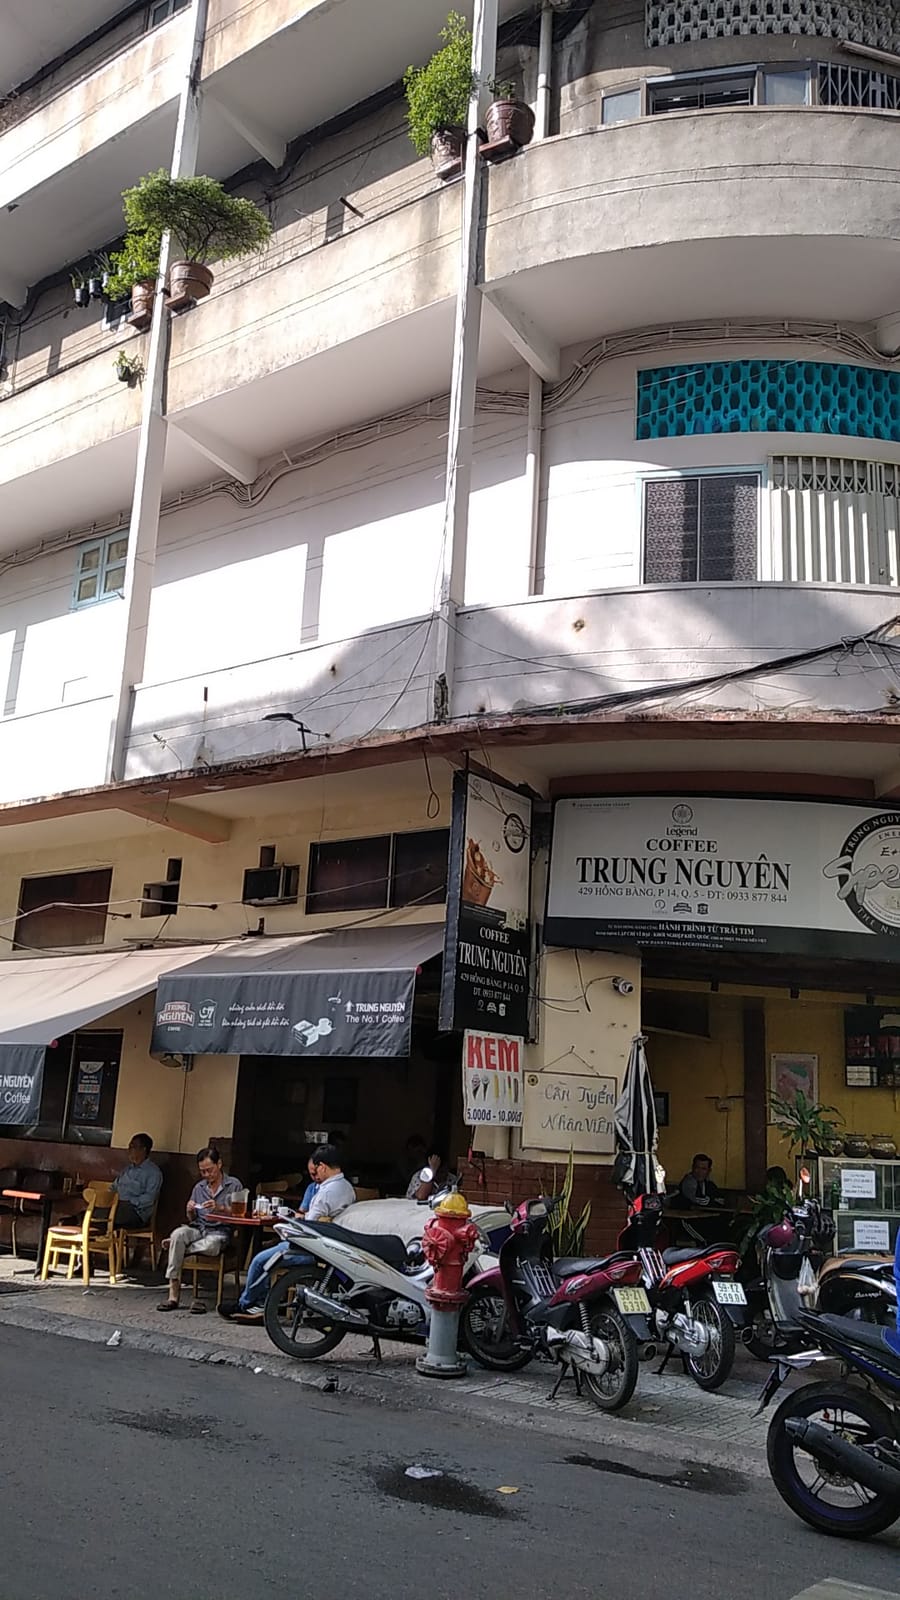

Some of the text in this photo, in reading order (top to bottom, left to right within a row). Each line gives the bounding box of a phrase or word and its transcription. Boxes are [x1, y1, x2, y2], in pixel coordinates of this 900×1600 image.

[666, 827, 698, 837] Legend
[646, 839, 718, 853] COFFEE
[576, 853, 791, 891] TRUNG NGUYÊN
[577, 887, 593, 895] 429
[595, 884, 623, 896] HỒNG
[658, 888, 664, 897] P
[693, 890, 699, 898] 5
[707, 891, 725, 900] ĐT:
[727, 892, 750, 901] 0933
[752, 893, 769, 902] 877
[771, 894, 788, 903] 844
[479, 926, 510, 944] COFFEE
[739, 927, 755, 935] TIM
[459, 941, 528, 977] TRUNG NGUYÊN
[356, 1001, 405, 1012] TRUNG NGUYÊN
[345, 1014, 405, 1023] The No.1 Coffee
[467, 1035, 519, 1072] KEM
[3, 1073, 35, 1088] NGUYÊN
[4, 1091, 31, 1104] Coffee
[467, 1108, 491, 1121] 5.000đ
[623, 1301, 646, 1312] 6330
